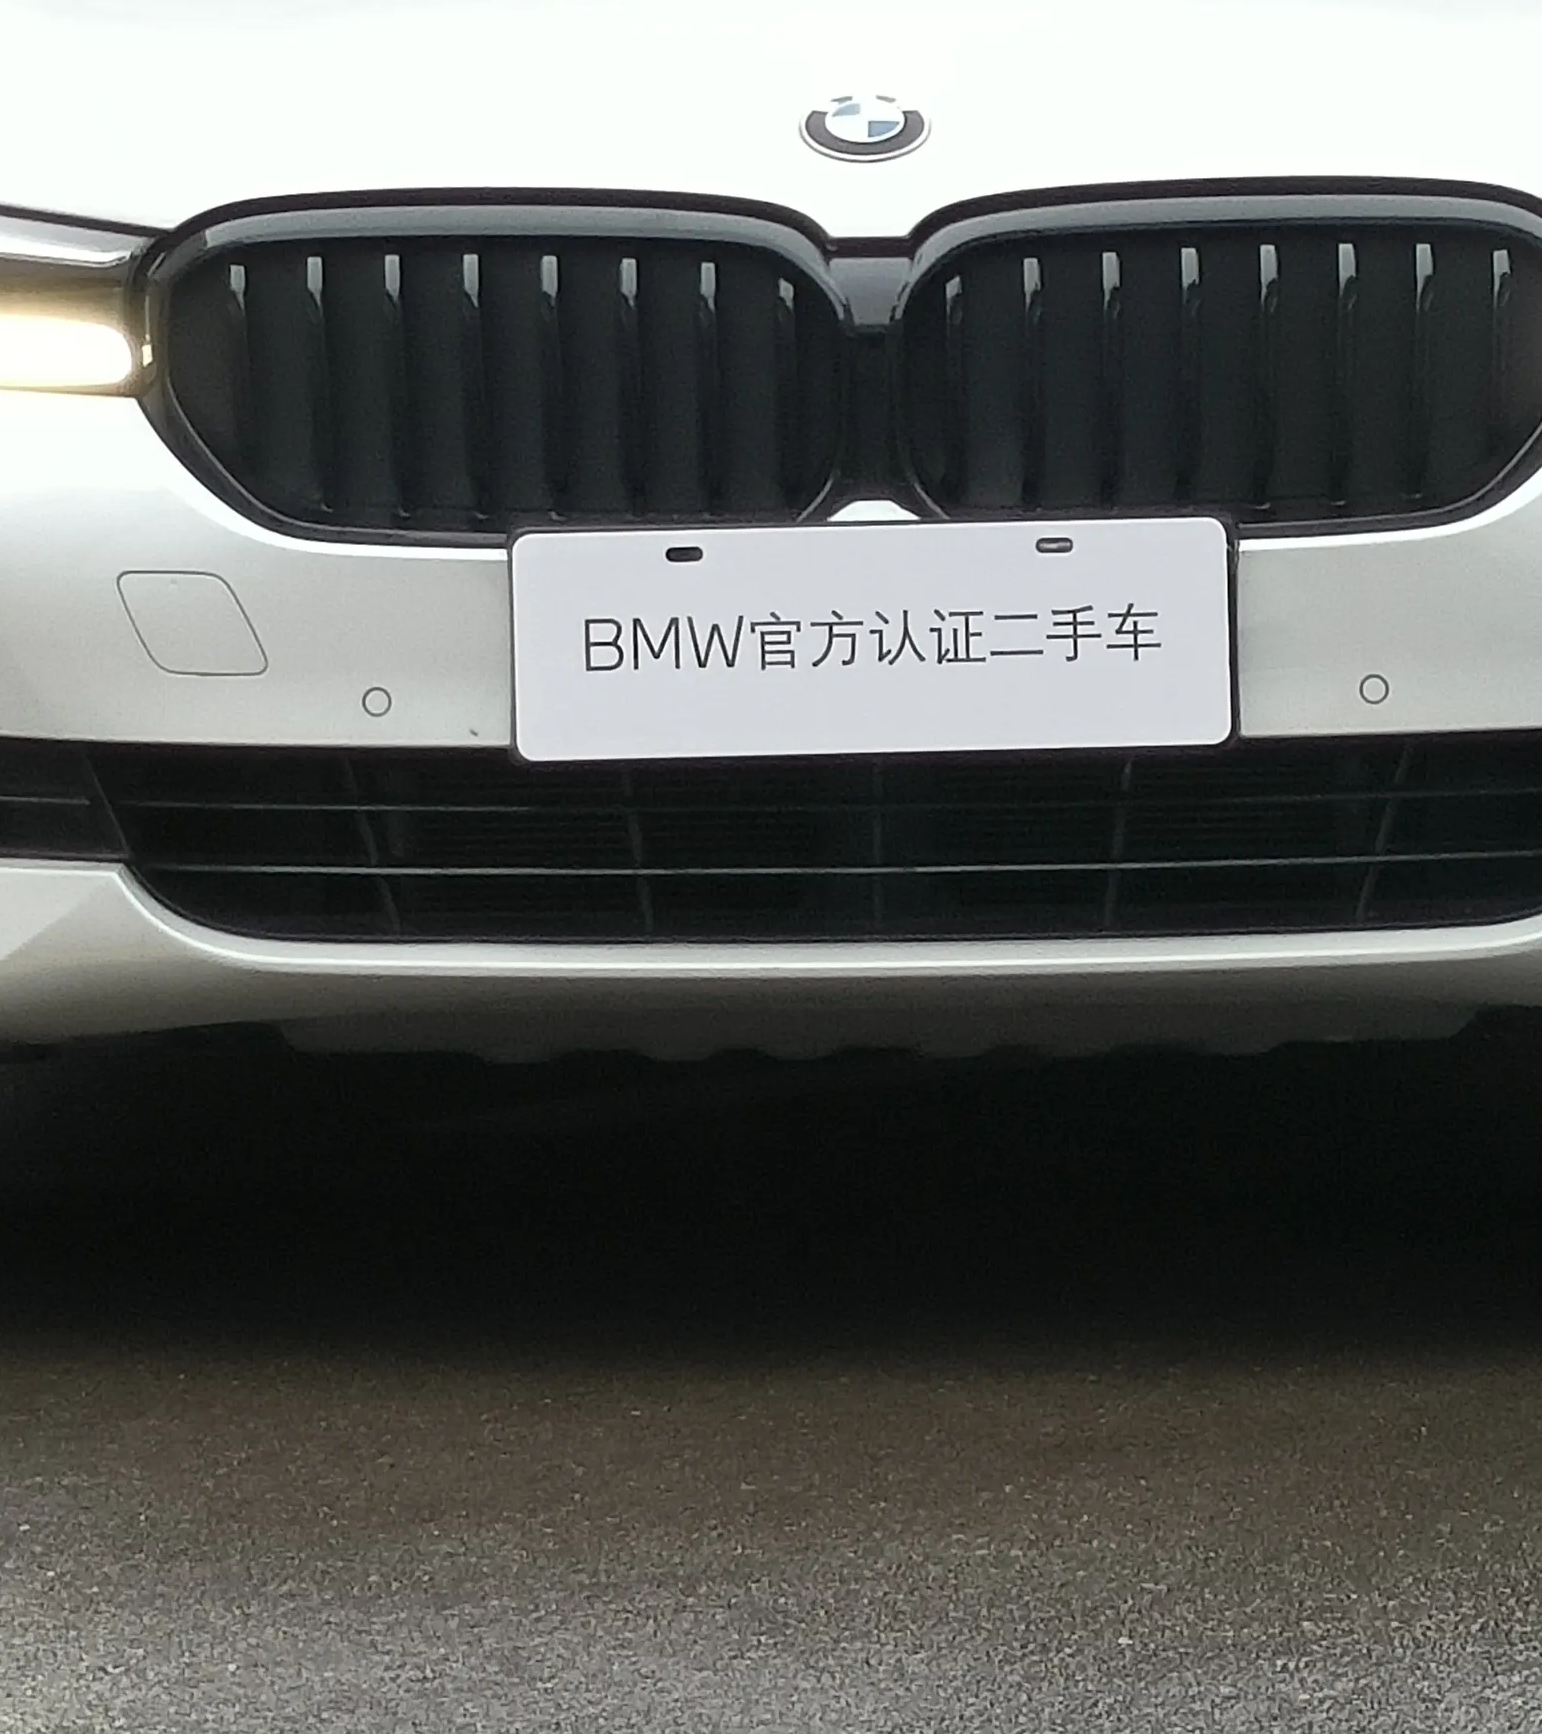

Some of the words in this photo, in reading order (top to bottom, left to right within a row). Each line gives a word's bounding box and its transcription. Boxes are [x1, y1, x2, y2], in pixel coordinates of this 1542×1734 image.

[584, 602, 1162, 672] BMW官方认证二手车
